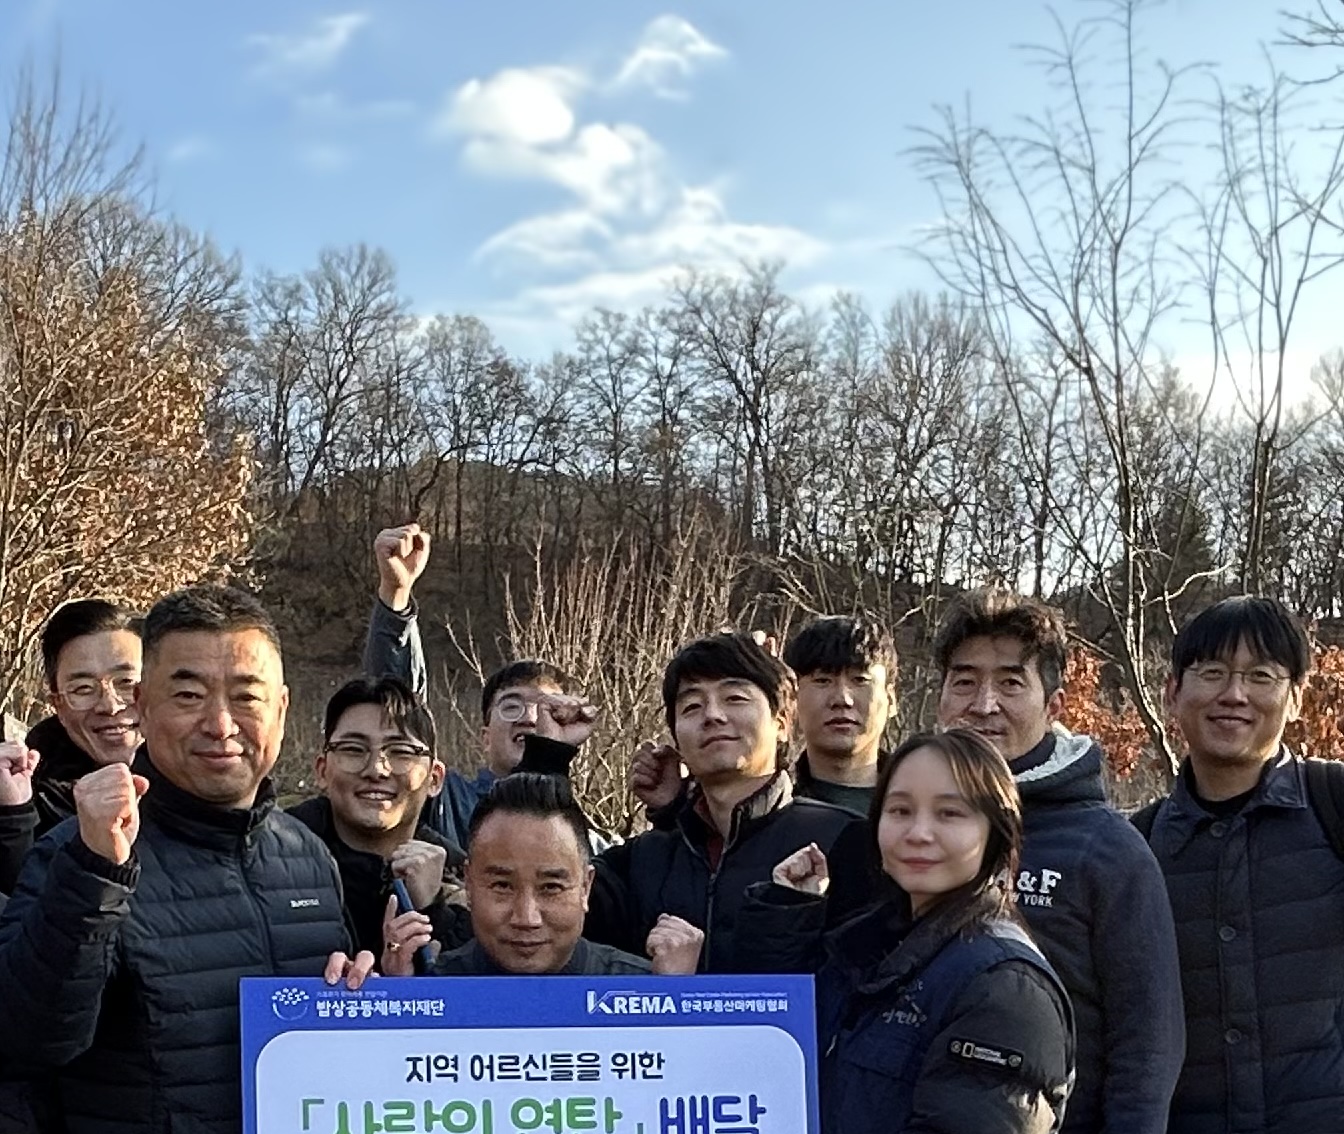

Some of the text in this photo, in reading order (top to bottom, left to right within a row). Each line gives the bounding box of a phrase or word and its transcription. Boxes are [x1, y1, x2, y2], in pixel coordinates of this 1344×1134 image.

[1023, 893, 1053, 908] YORK
[316, 999, 446, 1018] 밥상공동체복지재단
[586, 990, 677, 1015] KREMA
[680, 999, 788, 1013] 한국부동산마케팅협회
[404, 1050, 666, 1084] 지역 어르신들을 위한
